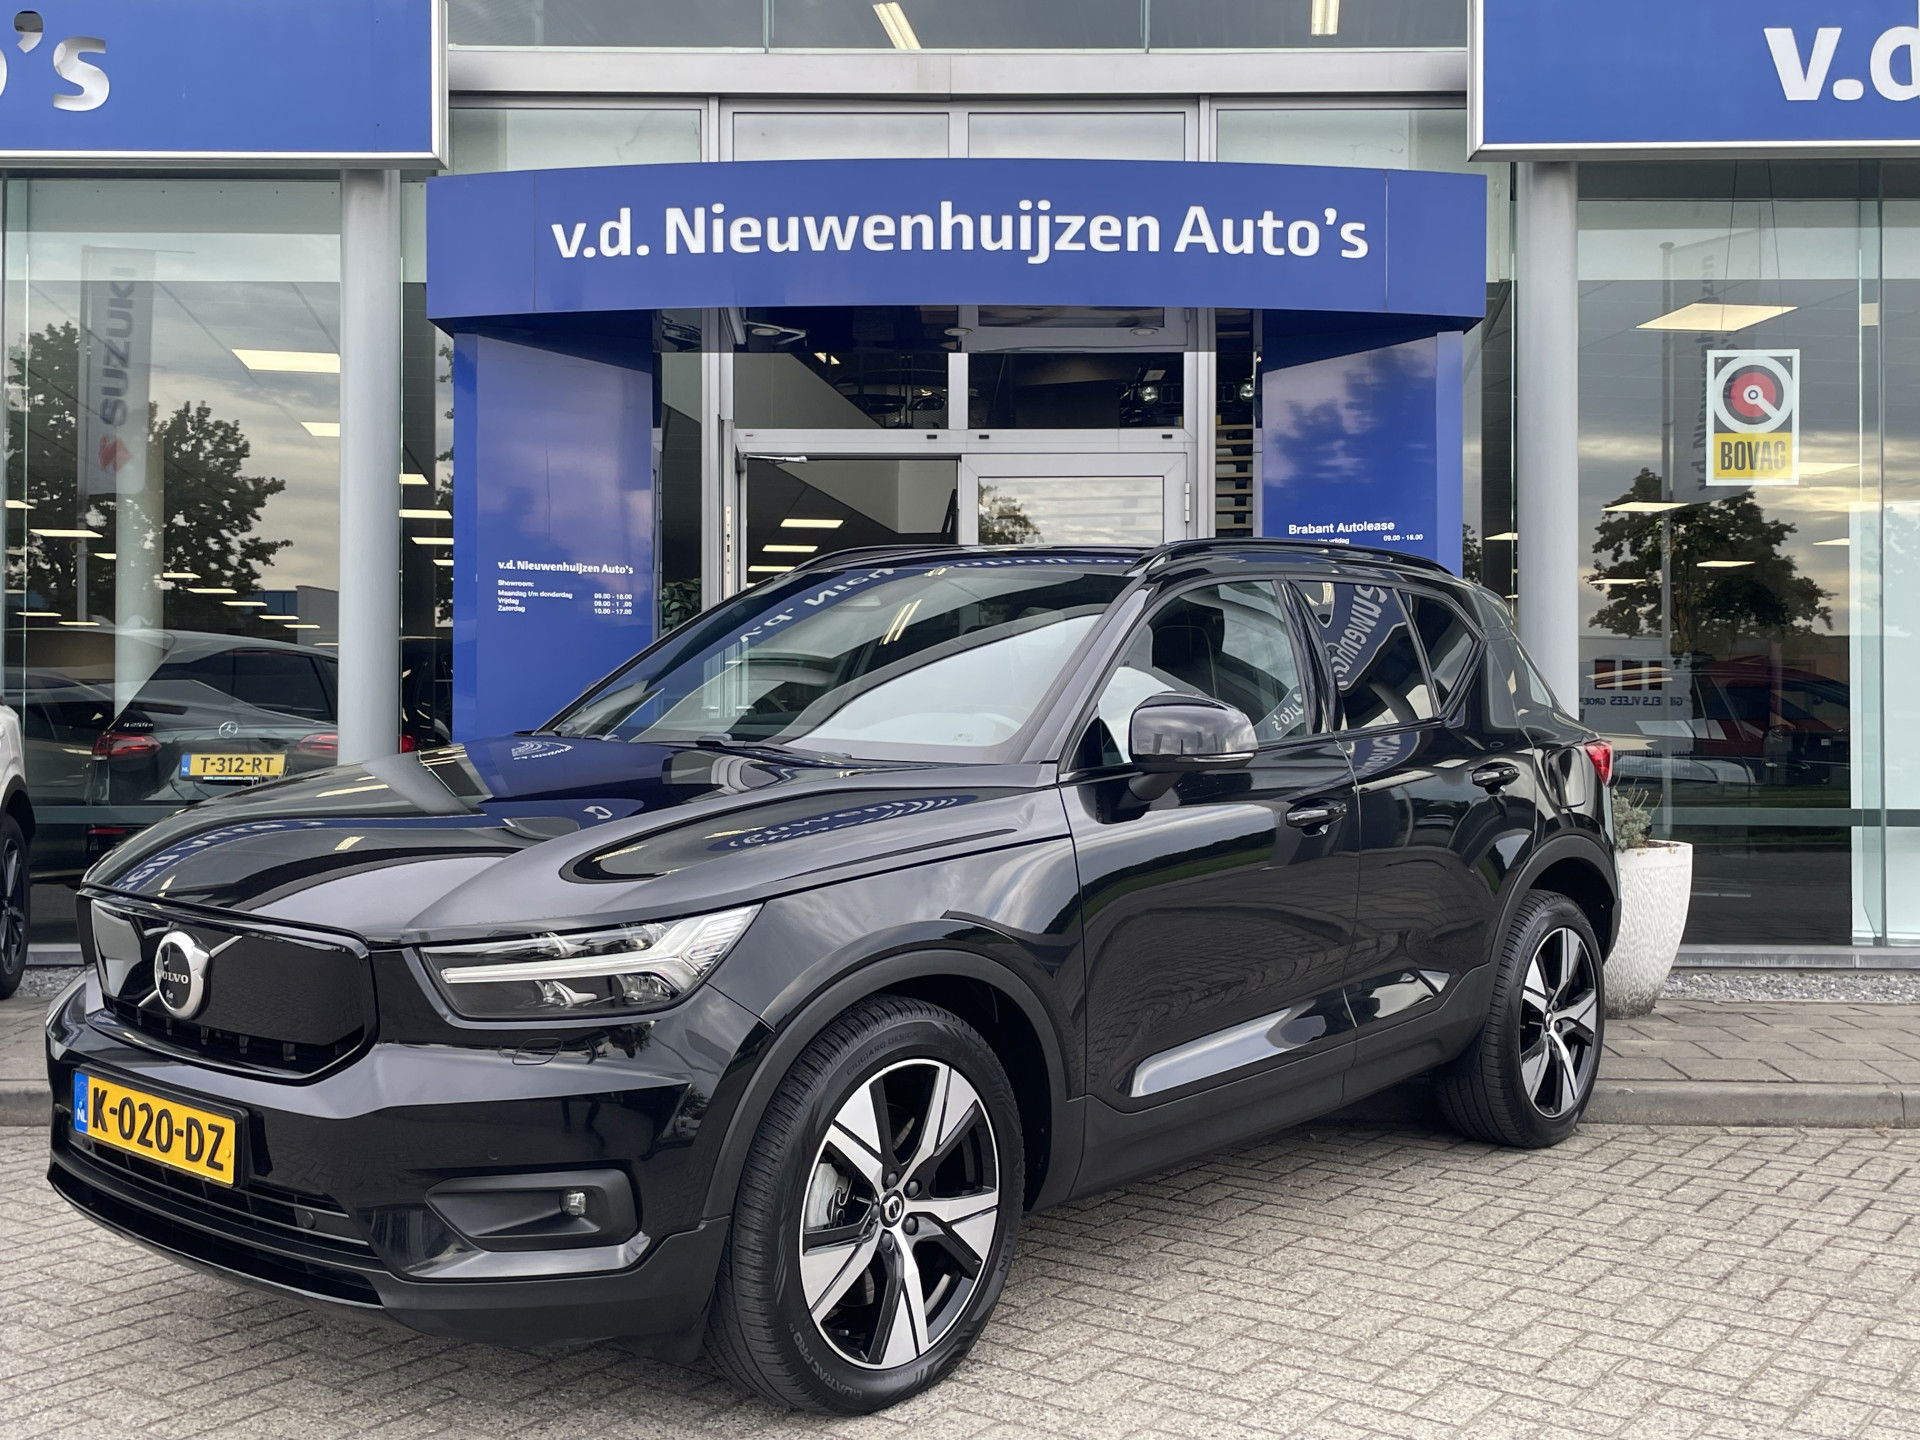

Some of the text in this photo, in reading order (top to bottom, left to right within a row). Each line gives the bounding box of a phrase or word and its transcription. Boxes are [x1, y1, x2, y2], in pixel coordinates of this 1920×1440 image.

[0, 10, 110, 112] 's
[551, 200, 1369, 264] v.d. Nieuwenhuijzen Auto's
[101, 267, 137, 427] SUZUKI
[1720, 440, 1786, 471] BOVAG
[1288, 521, 1395, 535] Brabant Autolease
[498, 560, 634, 574] v.d. Nieuwenhuijzen Auto's
[200, 757, 274, 773] T-312-RT
[156, 968, 189, 984] VOLVO
[76, 1087, 225, 1171] NL K-020-DZ
